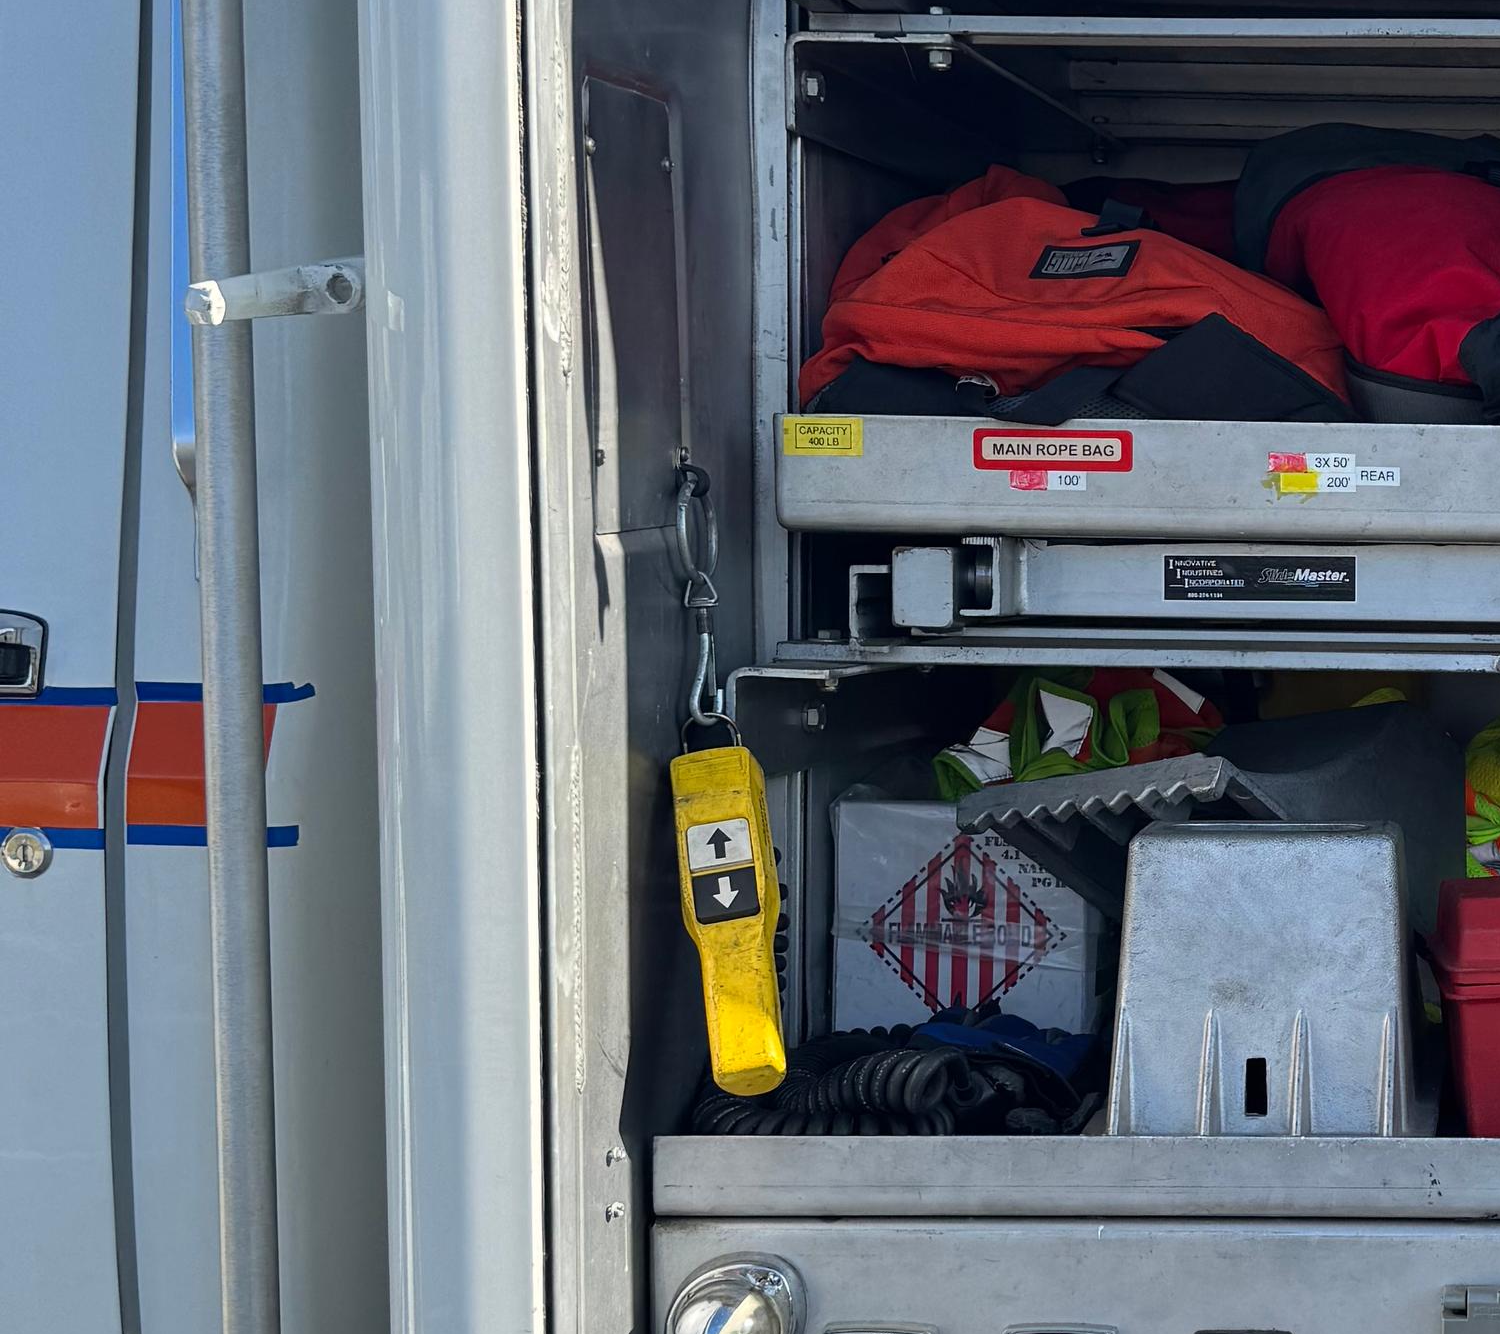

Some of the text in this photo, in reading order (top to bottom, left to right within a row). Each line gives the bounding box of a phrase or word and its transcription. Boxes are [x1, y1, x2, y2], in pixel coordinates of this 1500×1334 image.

[799, 426, 848, 436] CAPACITY
[808, 437, 840, 447] 400 LB
[992, 443, 1115, 457] MAIN ROPE BAG
[1315, 457, 1350, 468] 3X 50'
[1057, 475, 1081, 486] 100'
[1360, 471, 1395, 481] REAR
[1327, 478, 1351, 488] 200'
